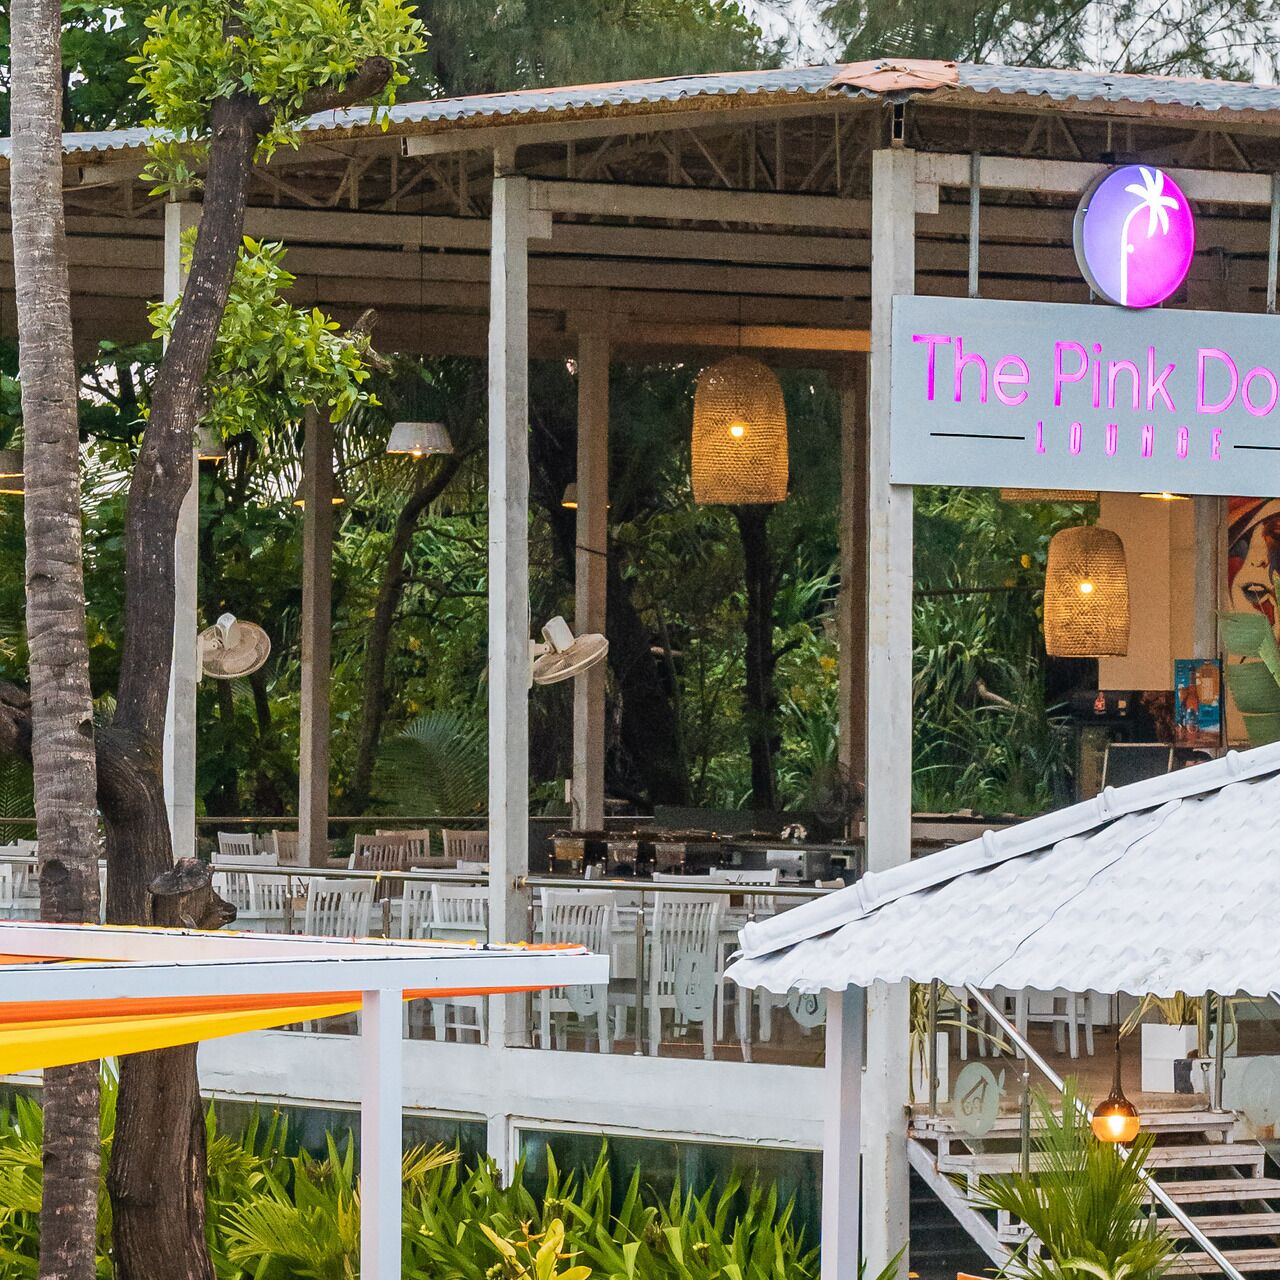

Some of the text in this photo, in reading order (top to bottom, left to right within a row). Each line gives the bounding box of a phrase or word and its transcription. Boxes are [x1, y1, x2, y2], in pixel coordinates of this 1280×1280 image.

[912, 334, 1030, 407] The
[1053, 341, 1176, 413] Pink
[1035, 421, 1223, 461] LOUNGE
